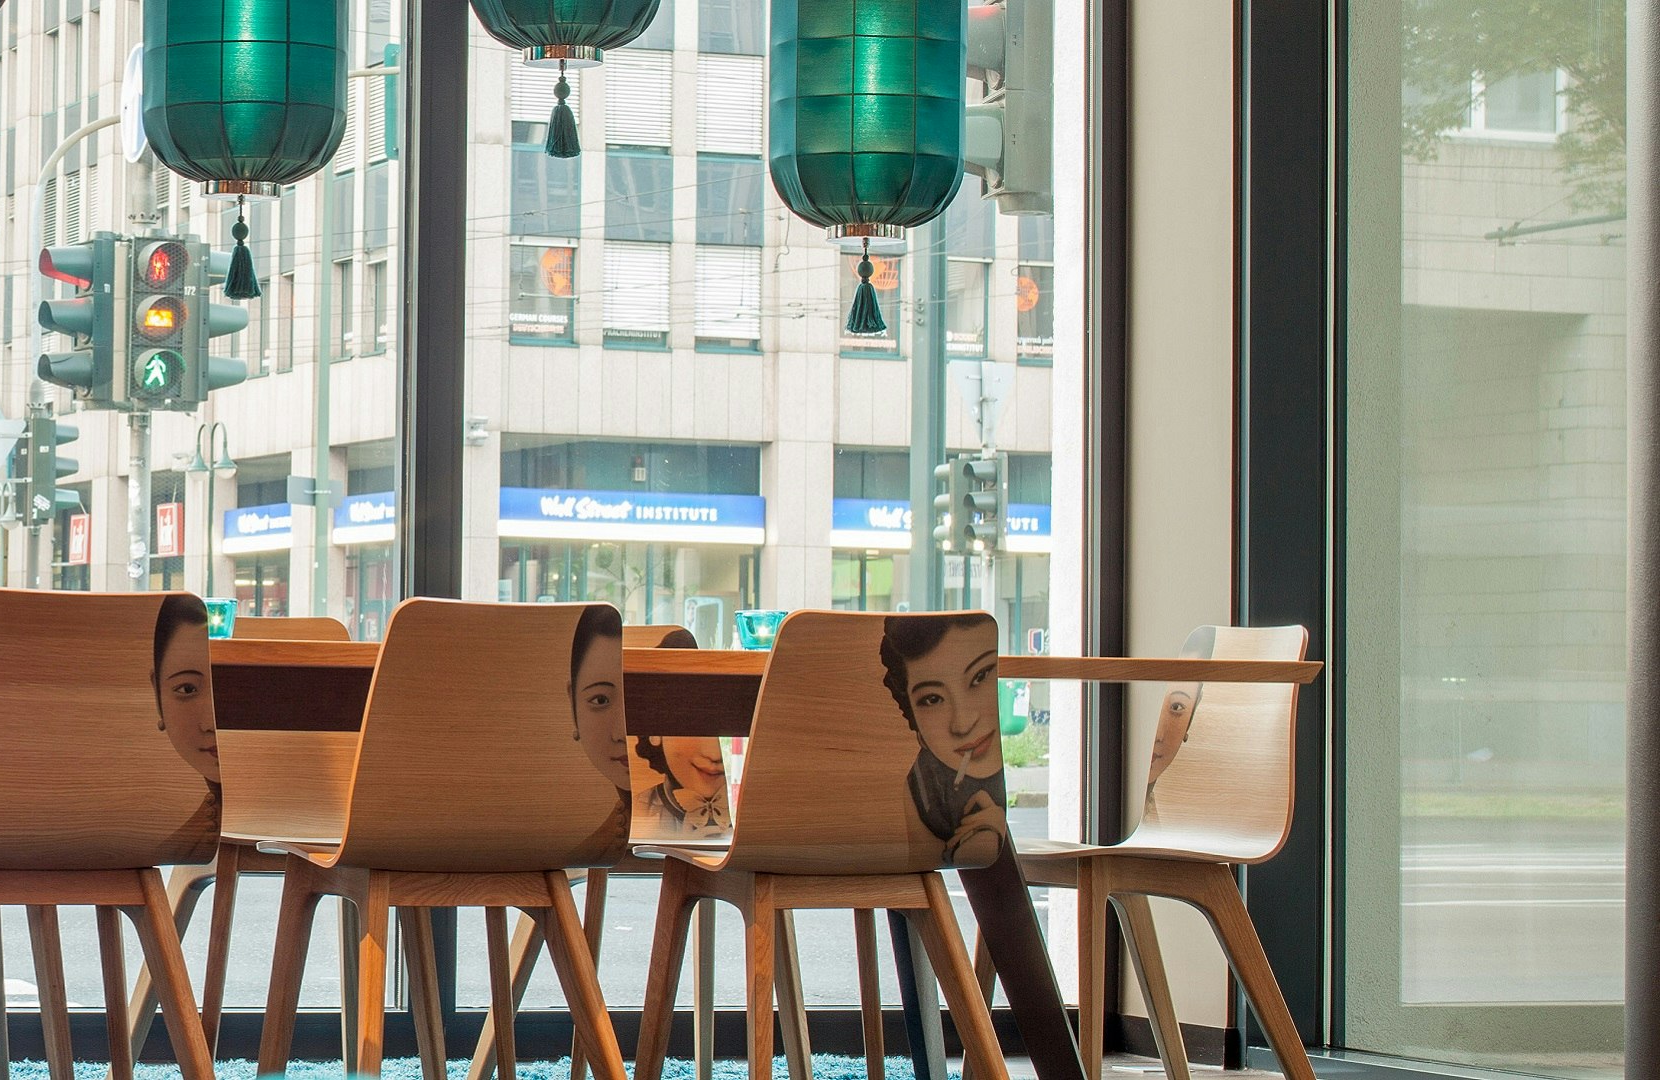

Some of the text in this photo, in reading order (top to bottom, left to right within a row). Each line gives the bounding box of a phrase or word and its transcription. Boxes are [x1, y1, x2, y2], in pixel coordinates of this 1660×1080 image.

[509, 313, 568, 323] GERMAN COURSES
[540, 495, 718, 522] Wall Street INSTITUTE
